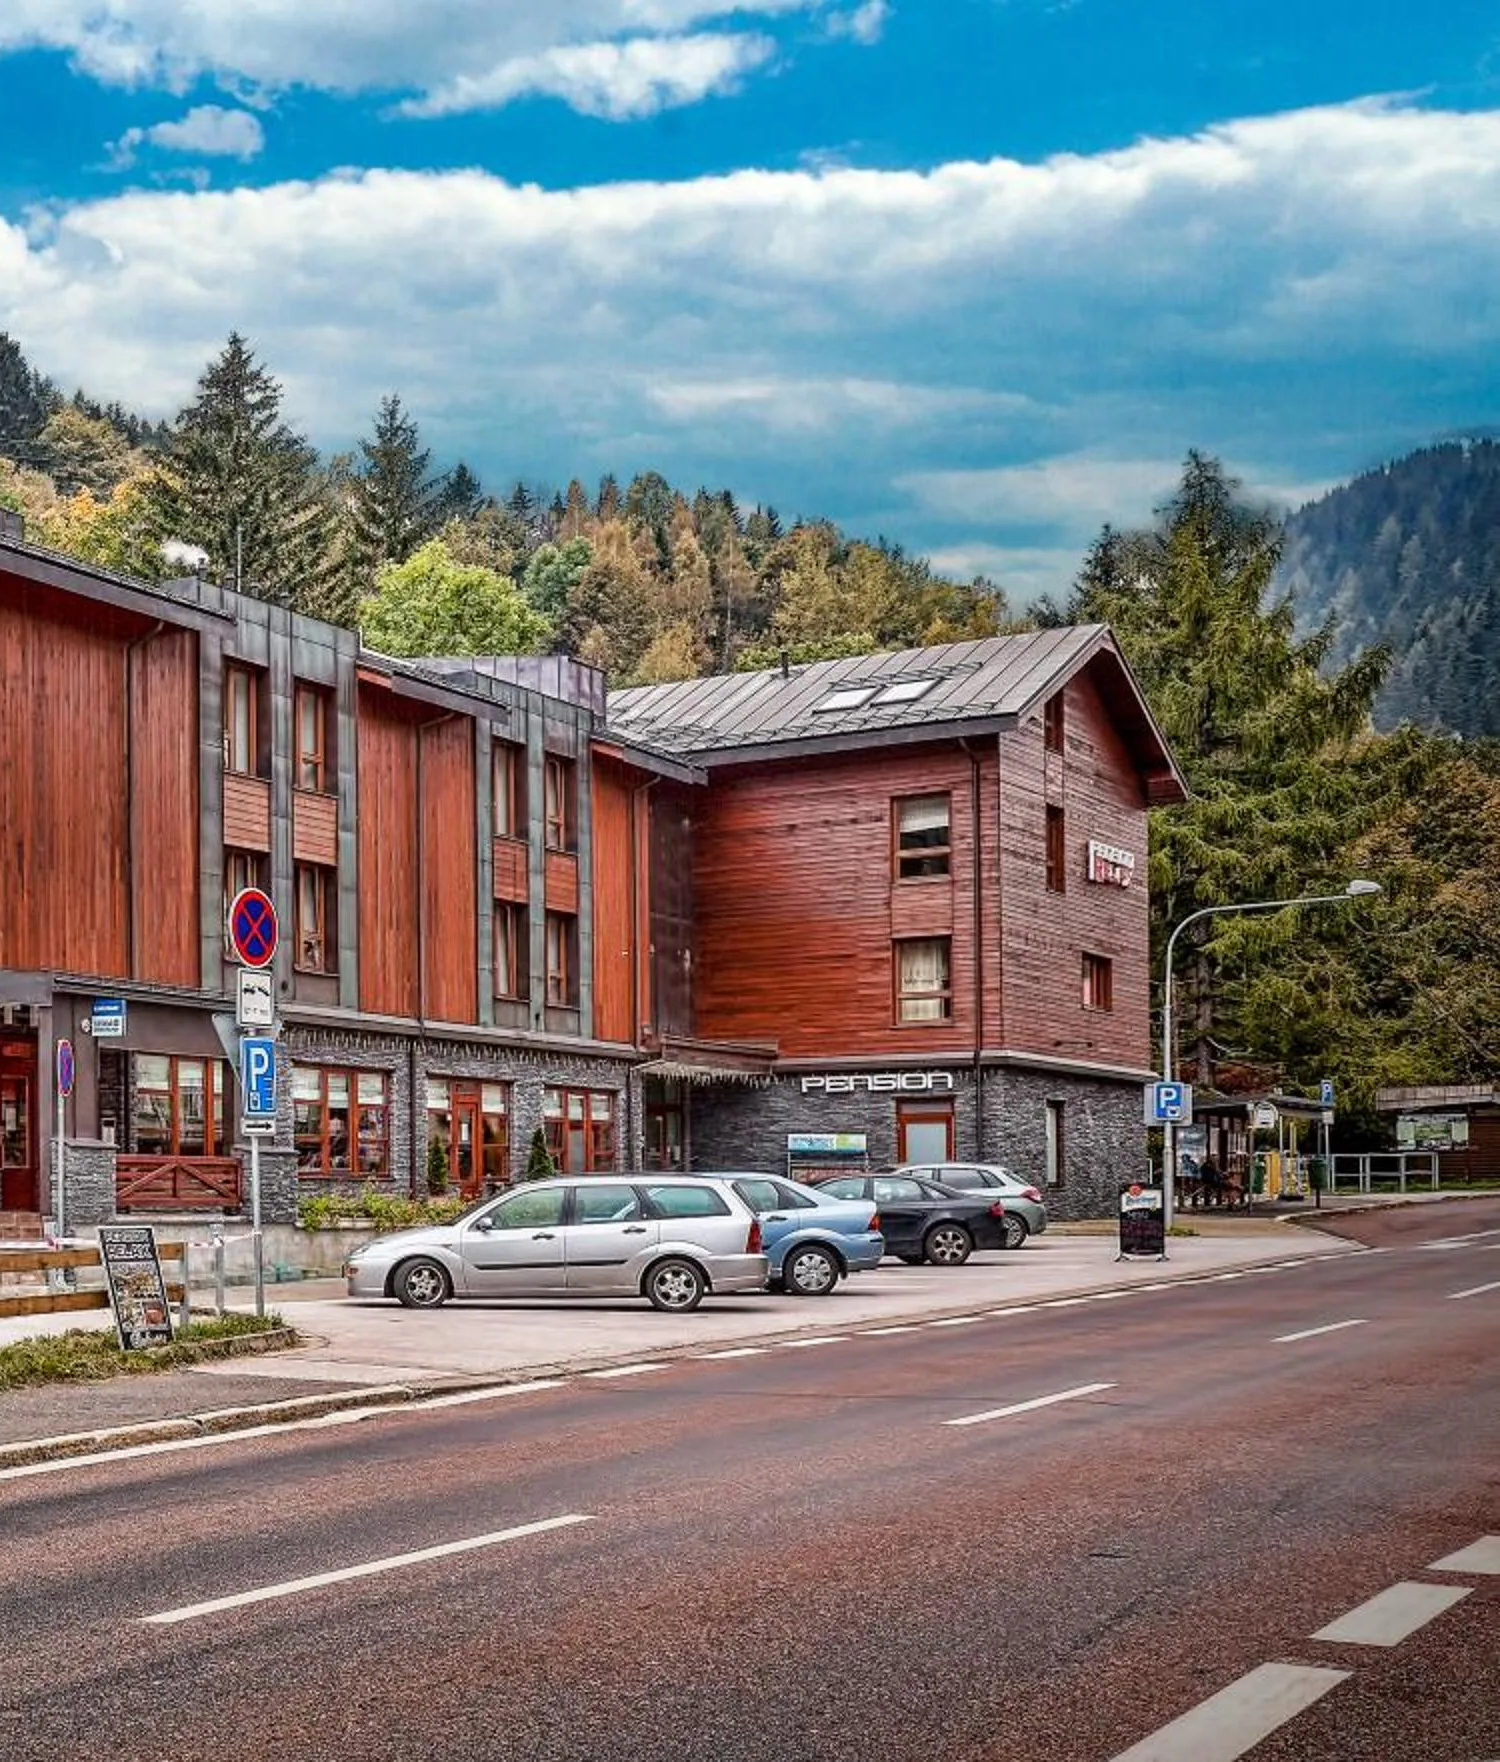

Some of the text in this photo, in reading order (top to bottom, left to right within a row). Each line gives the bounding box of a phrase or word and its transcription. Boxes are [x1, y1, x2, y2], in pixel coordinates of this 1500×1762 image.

[249, 1047, 269, 1091] P
[801, 1072, 954, 1094] PENSION
[1159, 1088, 1177, 1109] P
